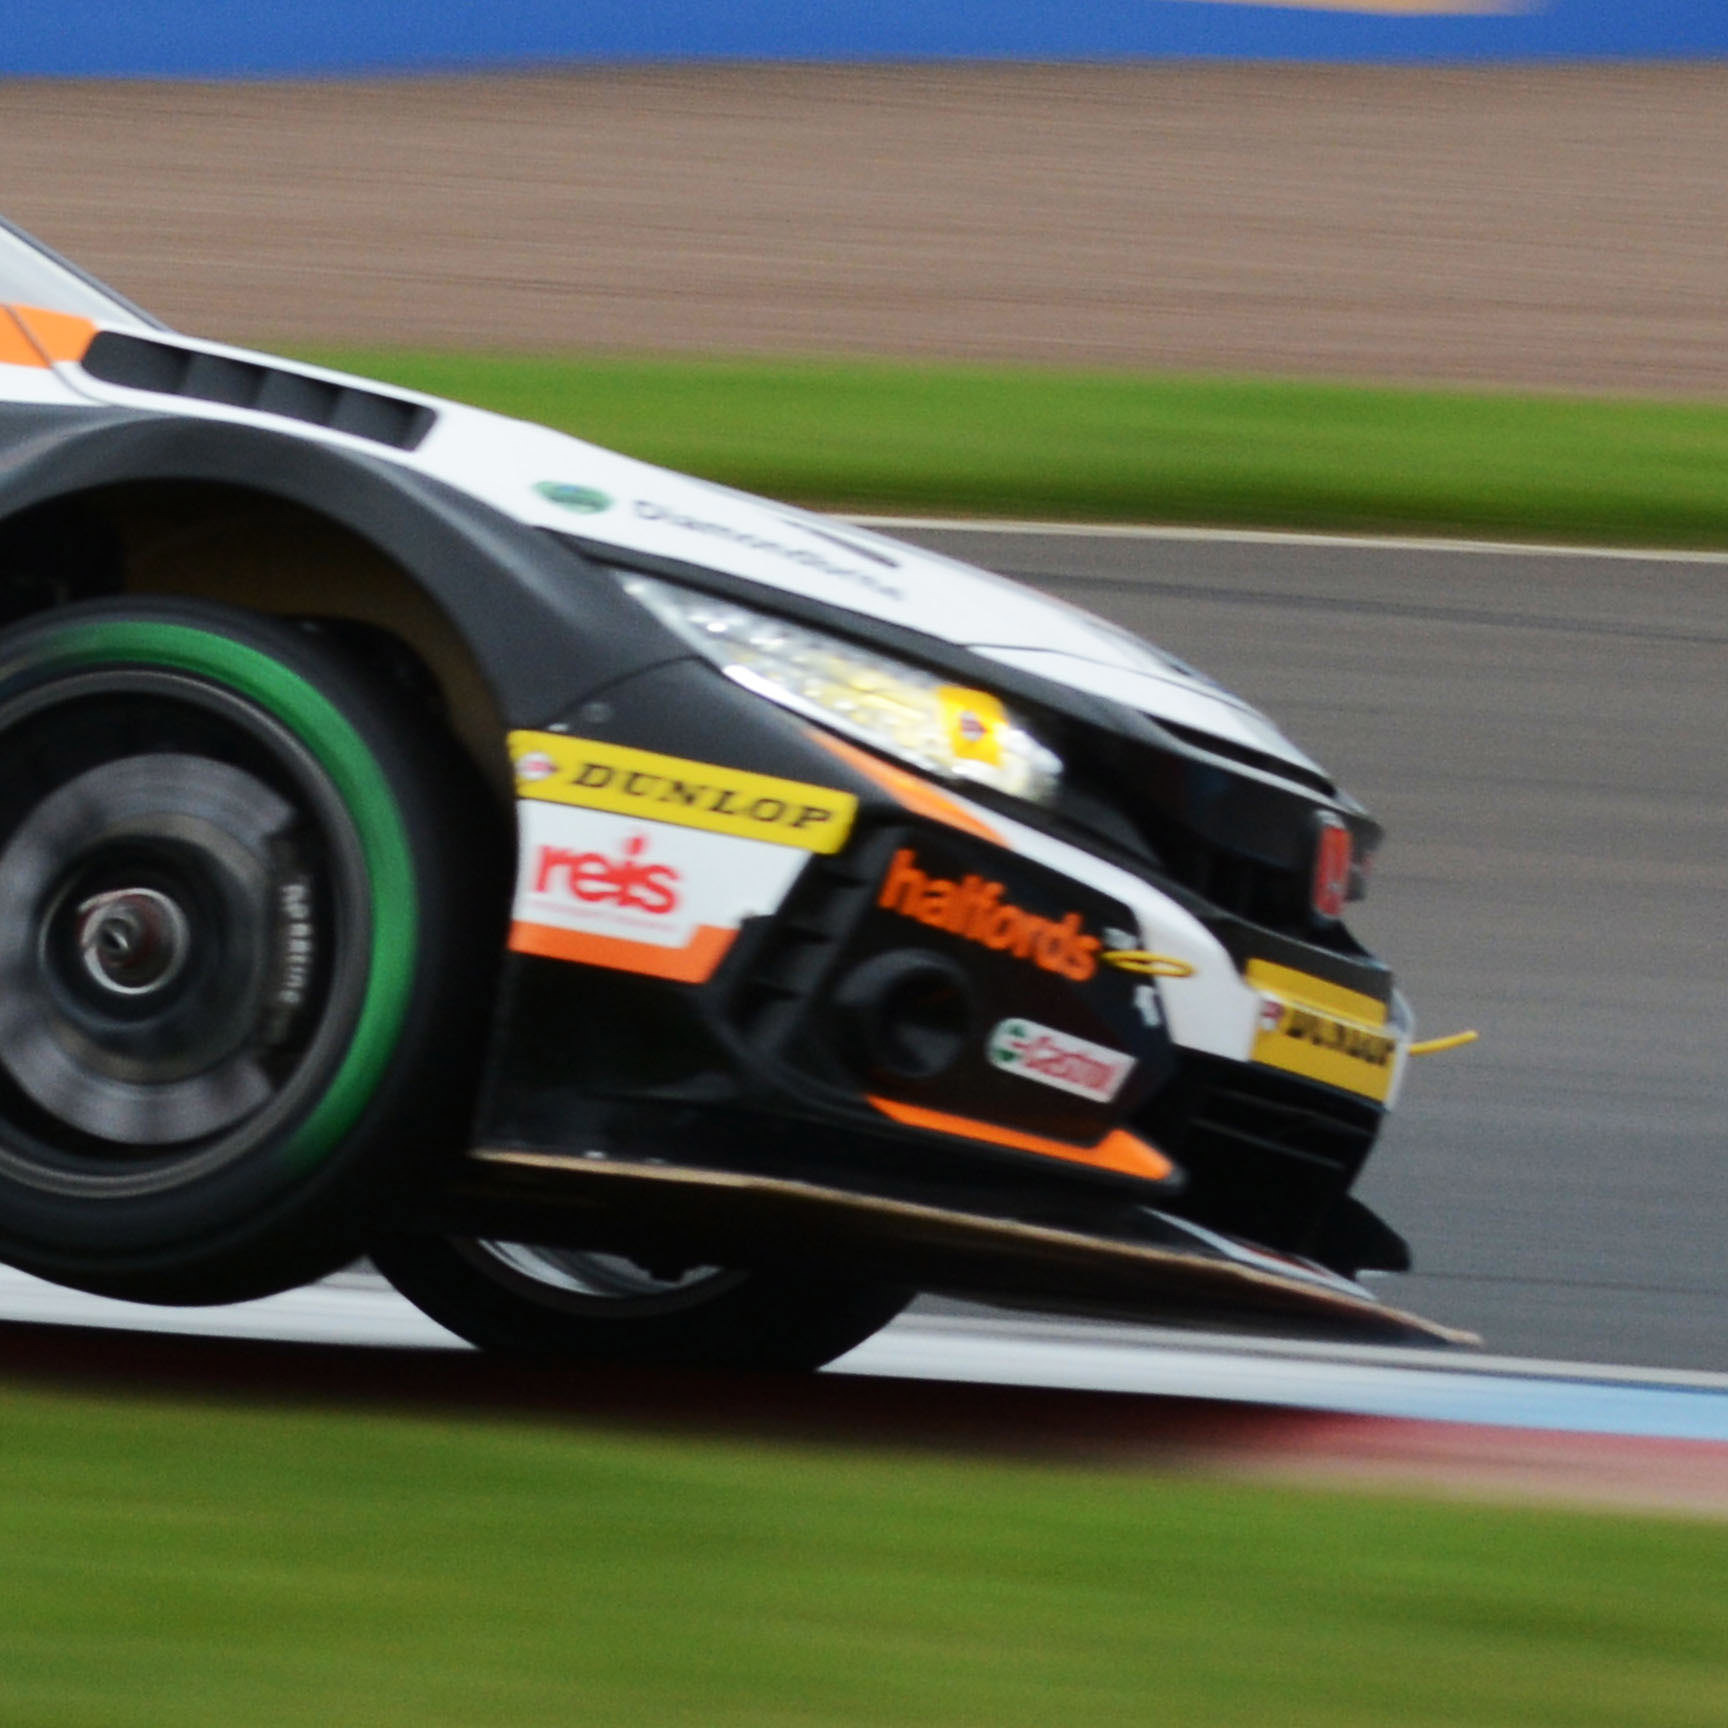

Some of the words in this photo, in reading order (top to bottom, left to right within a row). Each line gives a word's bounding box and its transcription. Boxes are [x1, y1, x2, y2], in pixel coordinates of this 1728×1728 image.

[571, 762, 833, 829] DUNLOP
[535, 836, 678, 915] reis
[880, 849, 1100, 981] halfords
